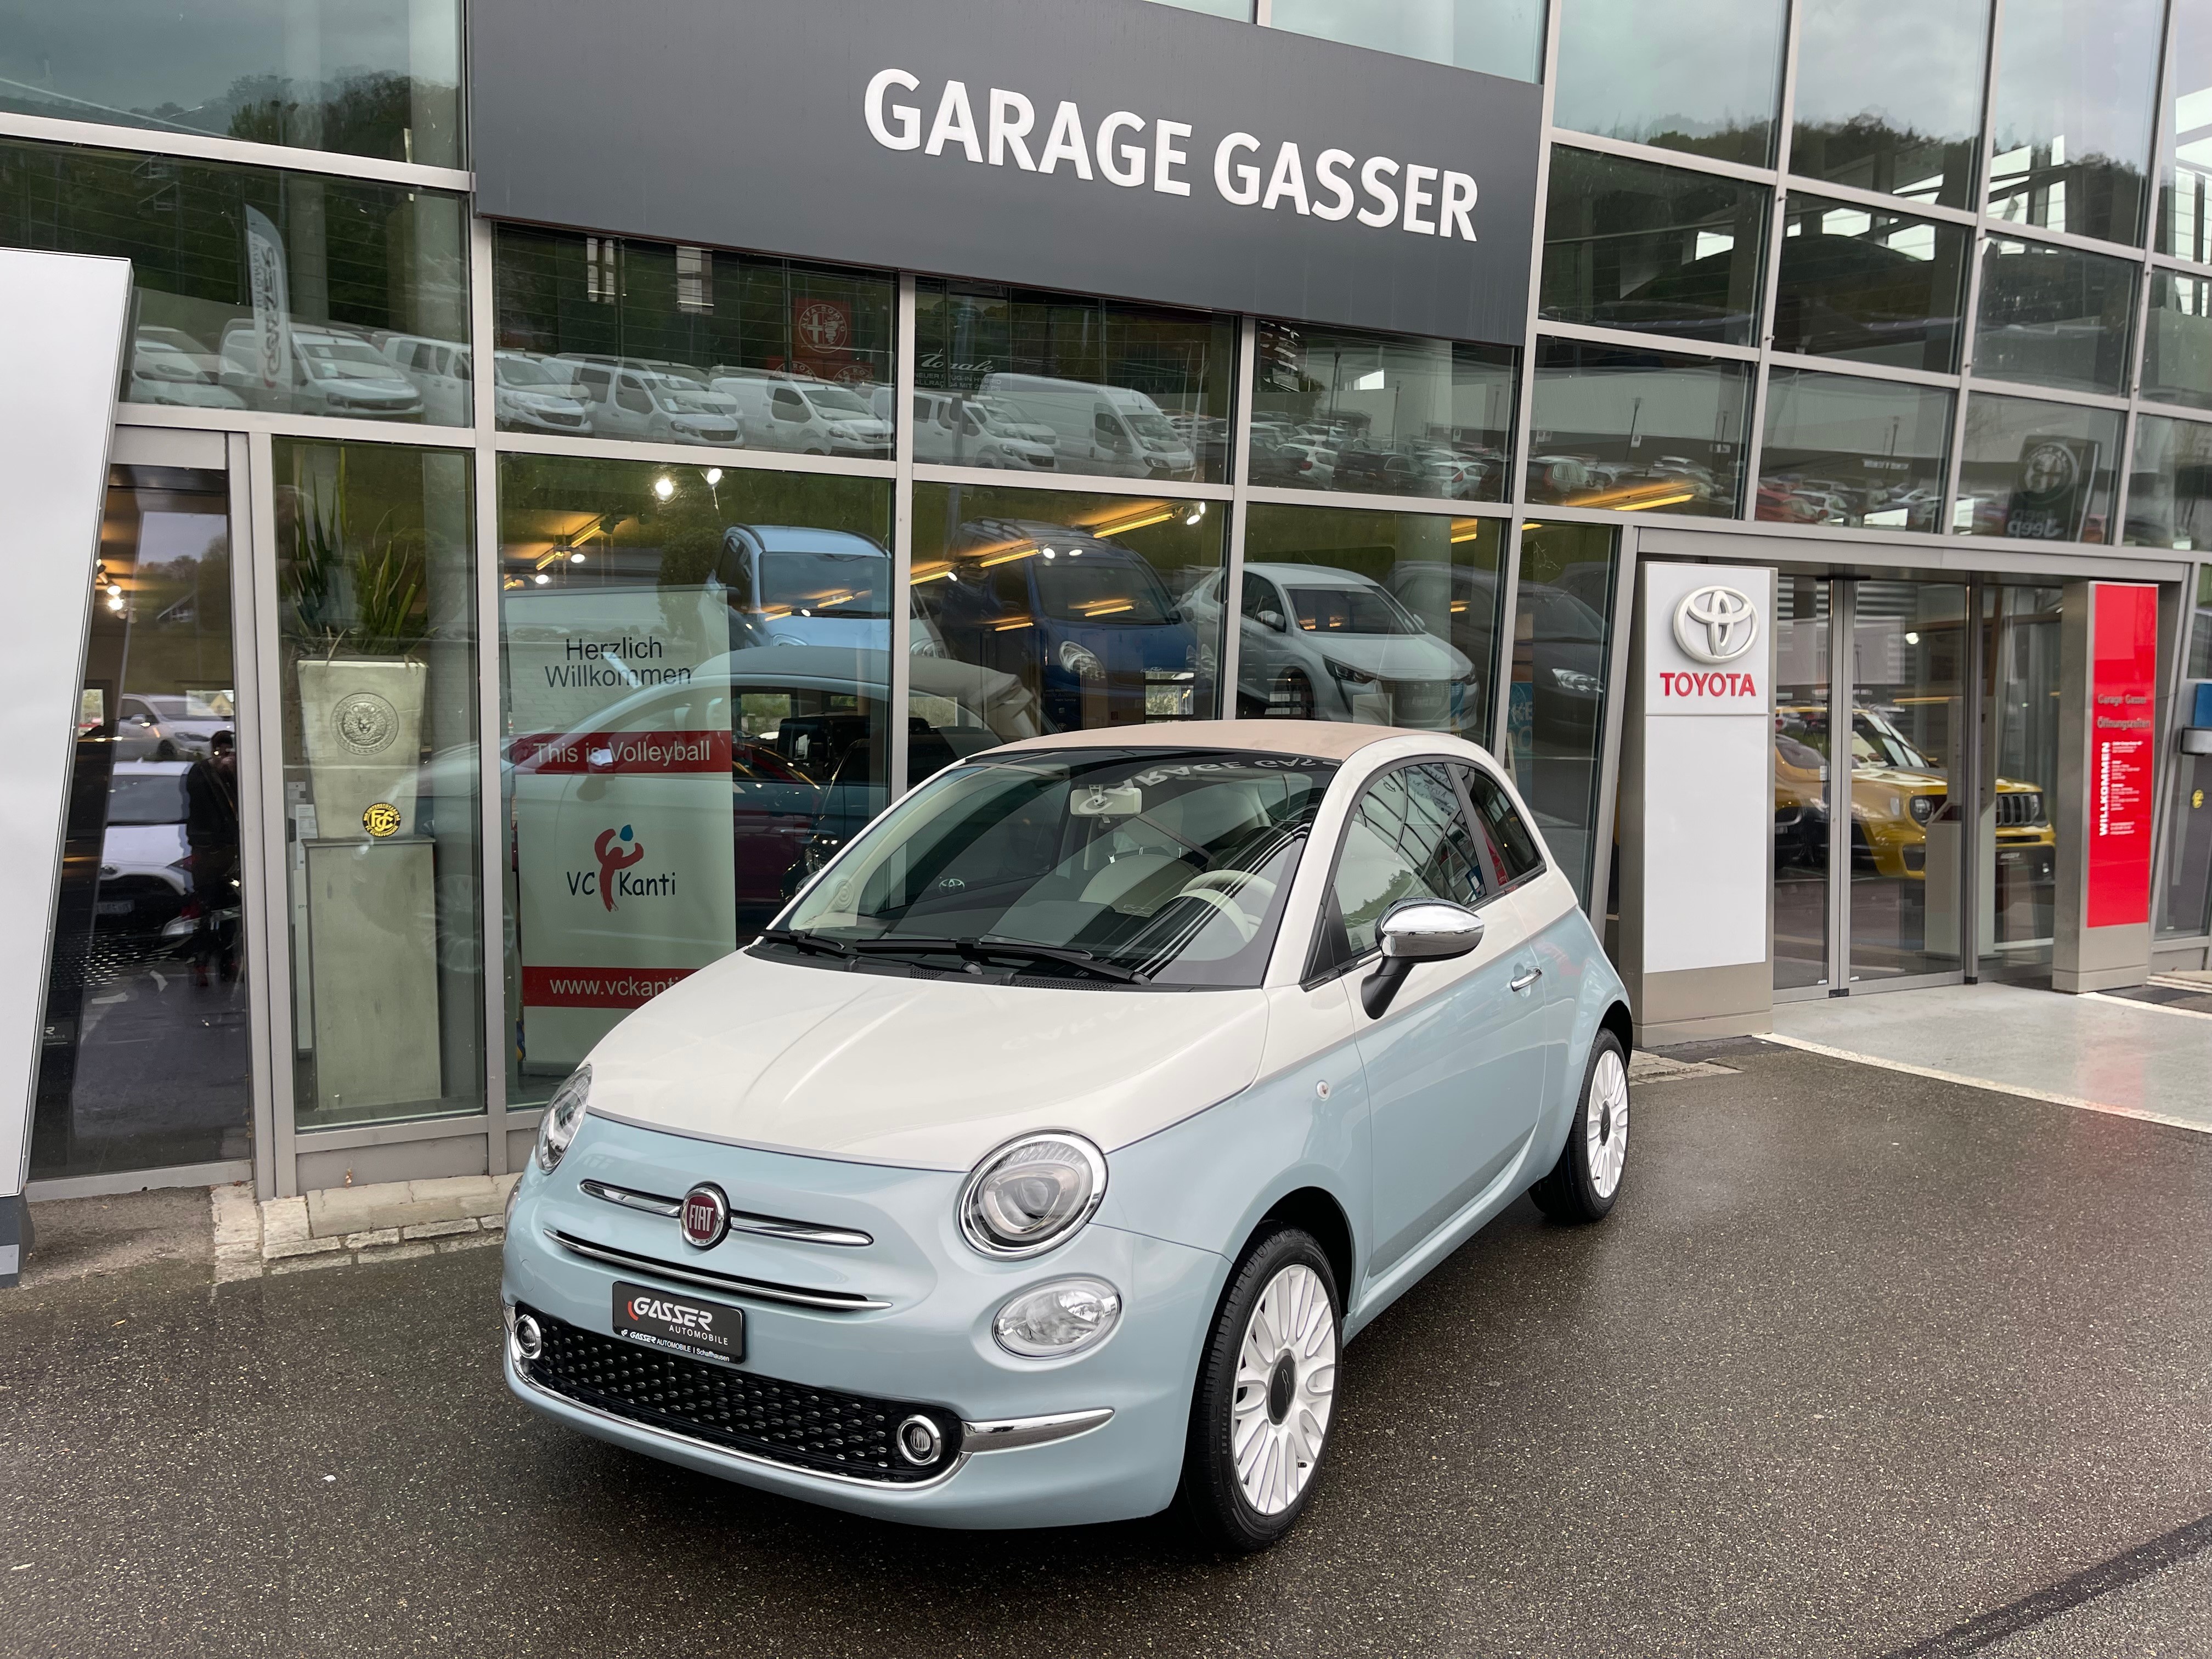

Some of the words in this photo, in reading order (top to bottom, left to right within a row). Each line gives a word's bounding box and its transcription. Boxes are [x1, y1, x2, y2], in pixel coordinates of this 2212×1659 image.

[865, 67, 1193, 197] GARAGE
[1214, 132, 1478, 242] GASSER
[800, 307, 817, 329] ALFA
[821, 306, 846, 332] ROMEO
[566, 636, 663, 661] Herzlich
[544, 664, 691, 688] Willkommen
[1660, 672, 1757, 697] TOYOTA
[533, 742, 579, 764] This
[607, 740, 710, 767] Volleyball
[2099, 742, 2111, 837] WILLKOMMEN
[566, 871, 595, 896] VC
[619, 871, 676, 896] Kanti
[689, 1204, 714, 1232] FIAT
[633, 1296, 713, 1331] GASSER
[630, 1331, 657, 1344] GASSER
[656, 1338, 692, 1353] AUTOMOBILE
[696, 1348, 730, 1362] Schaffhausen
[668, 1324, 729, 1346] AUTOMOBILE
